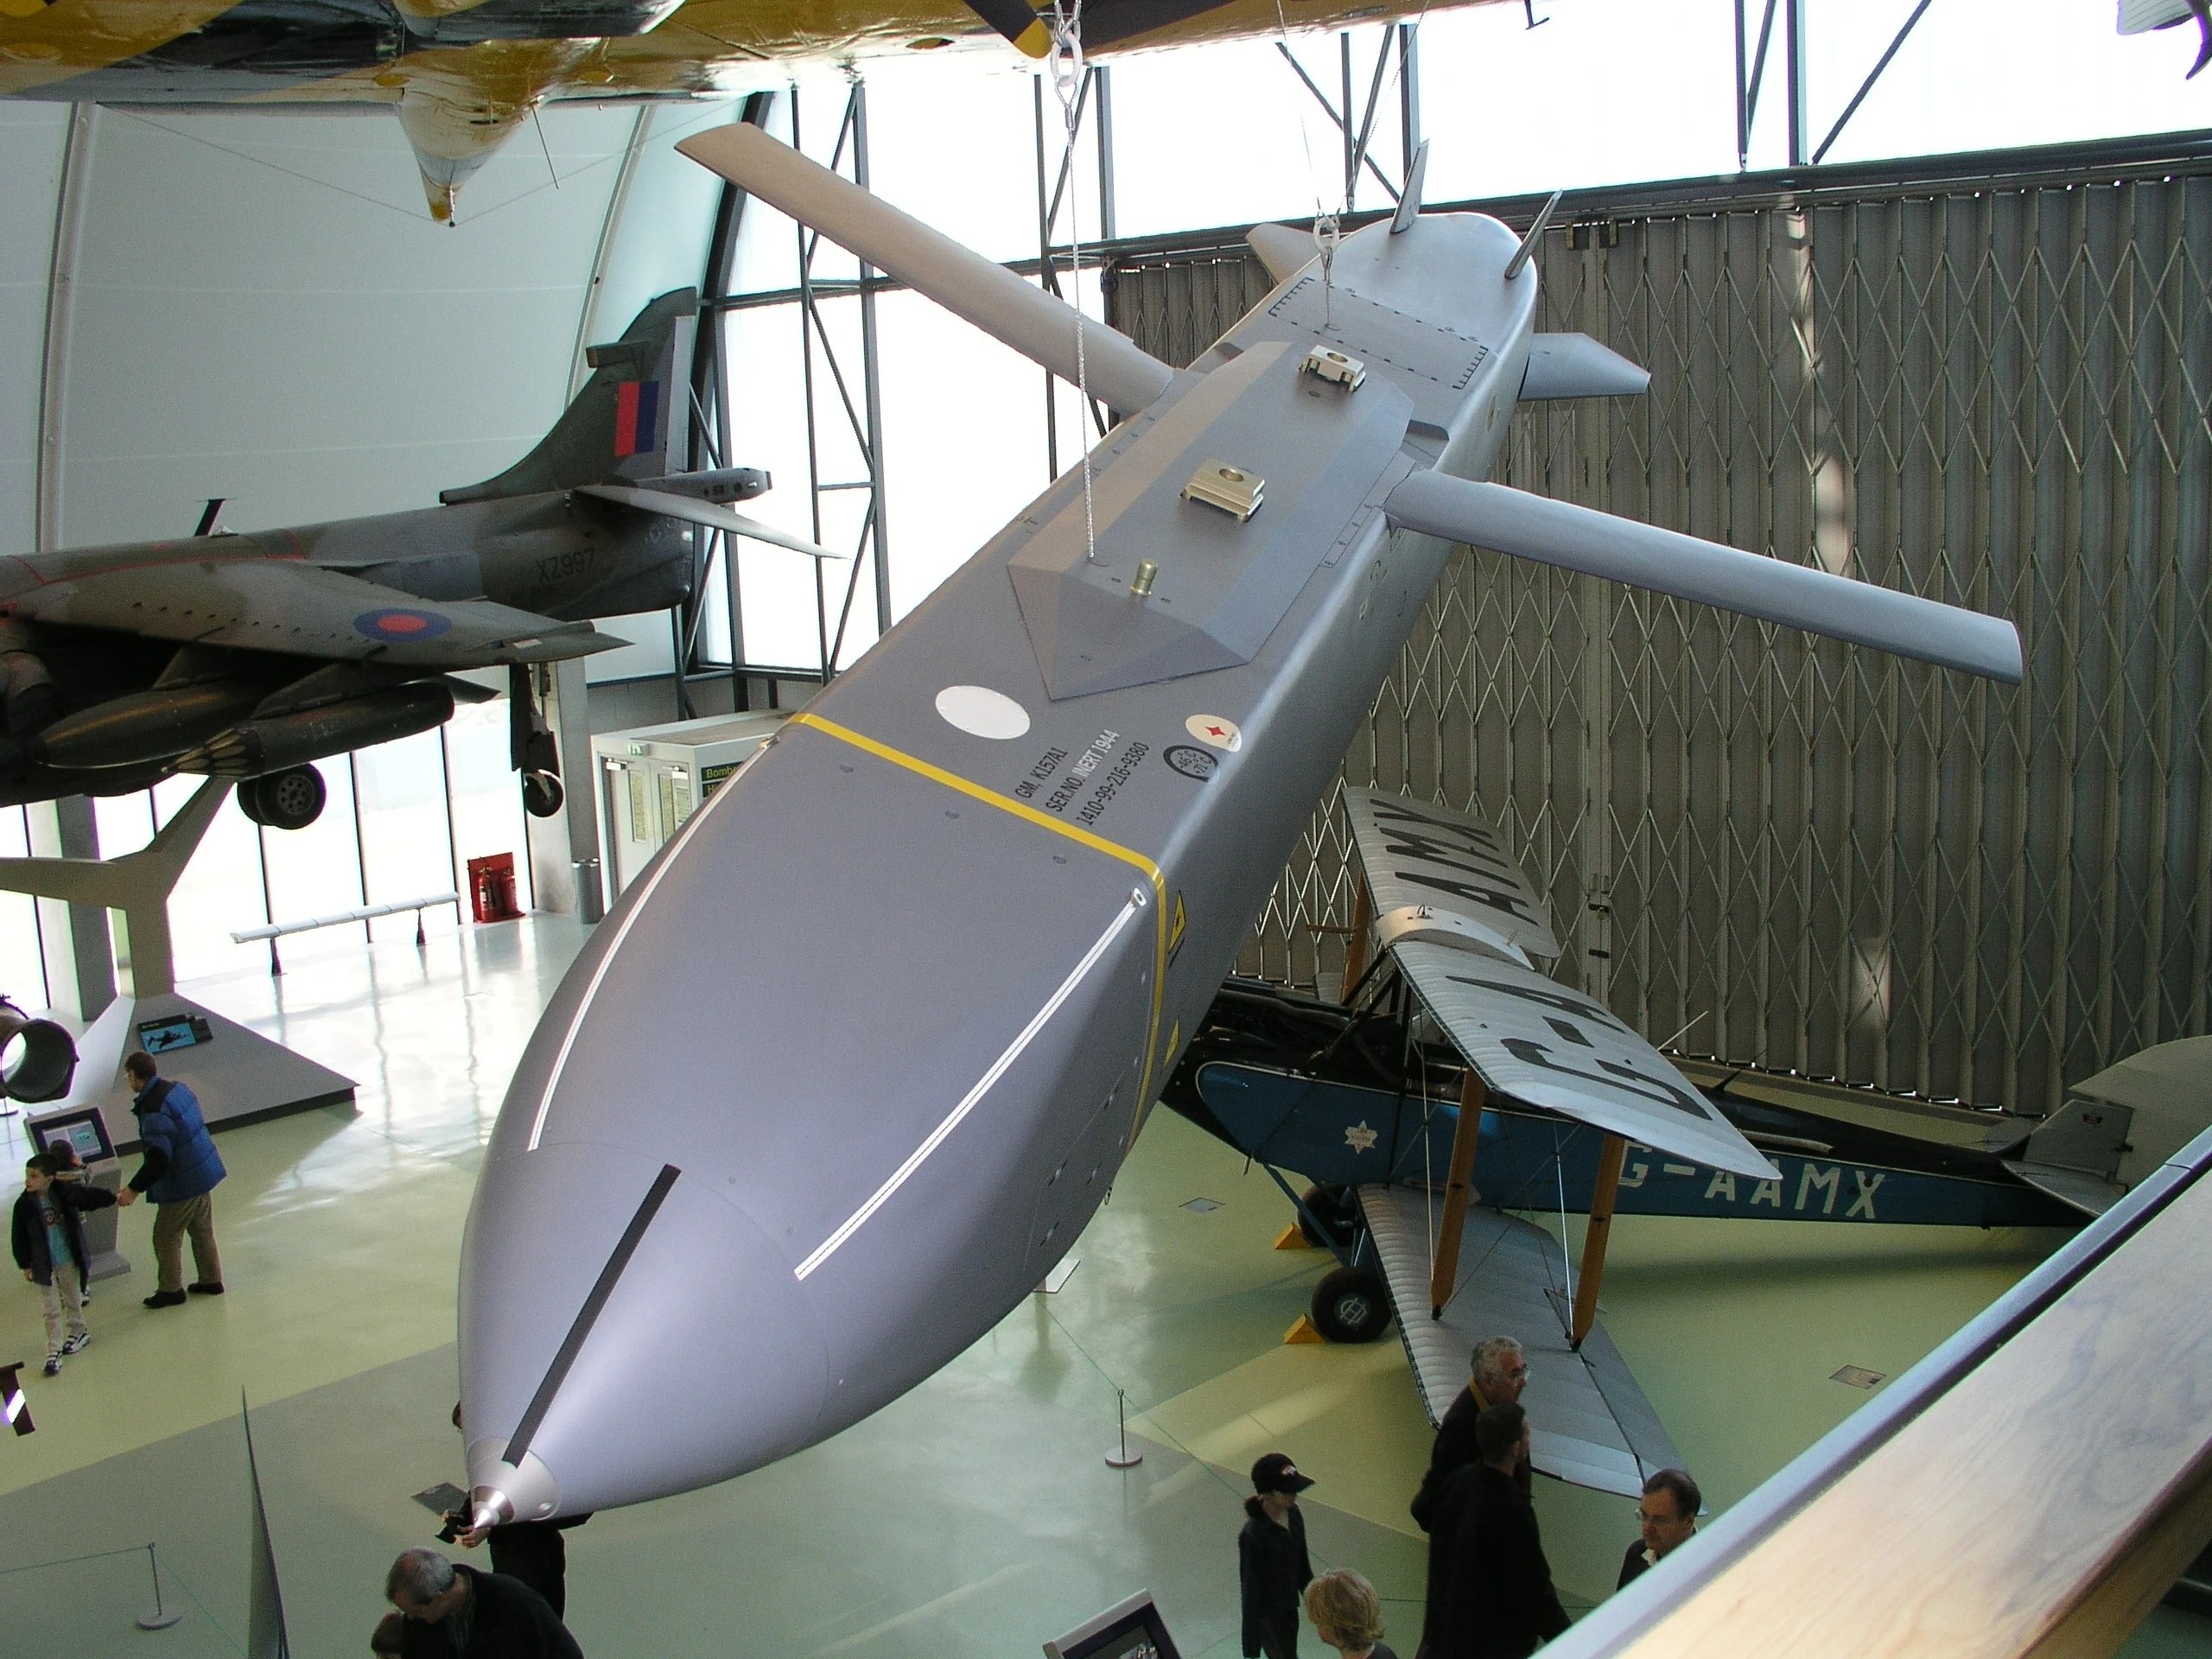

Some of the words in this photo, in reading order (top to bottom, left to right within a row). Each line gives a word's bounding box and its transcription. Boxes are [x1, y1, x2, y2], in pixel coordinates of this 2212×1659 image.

[1091, 728, 1121, 754] 1944
[706, 766, 737, 779] Bomb
[1030, 747, 1068, 782] K157A1
[1617, 1140, 1886, 1219] G-AAMX
